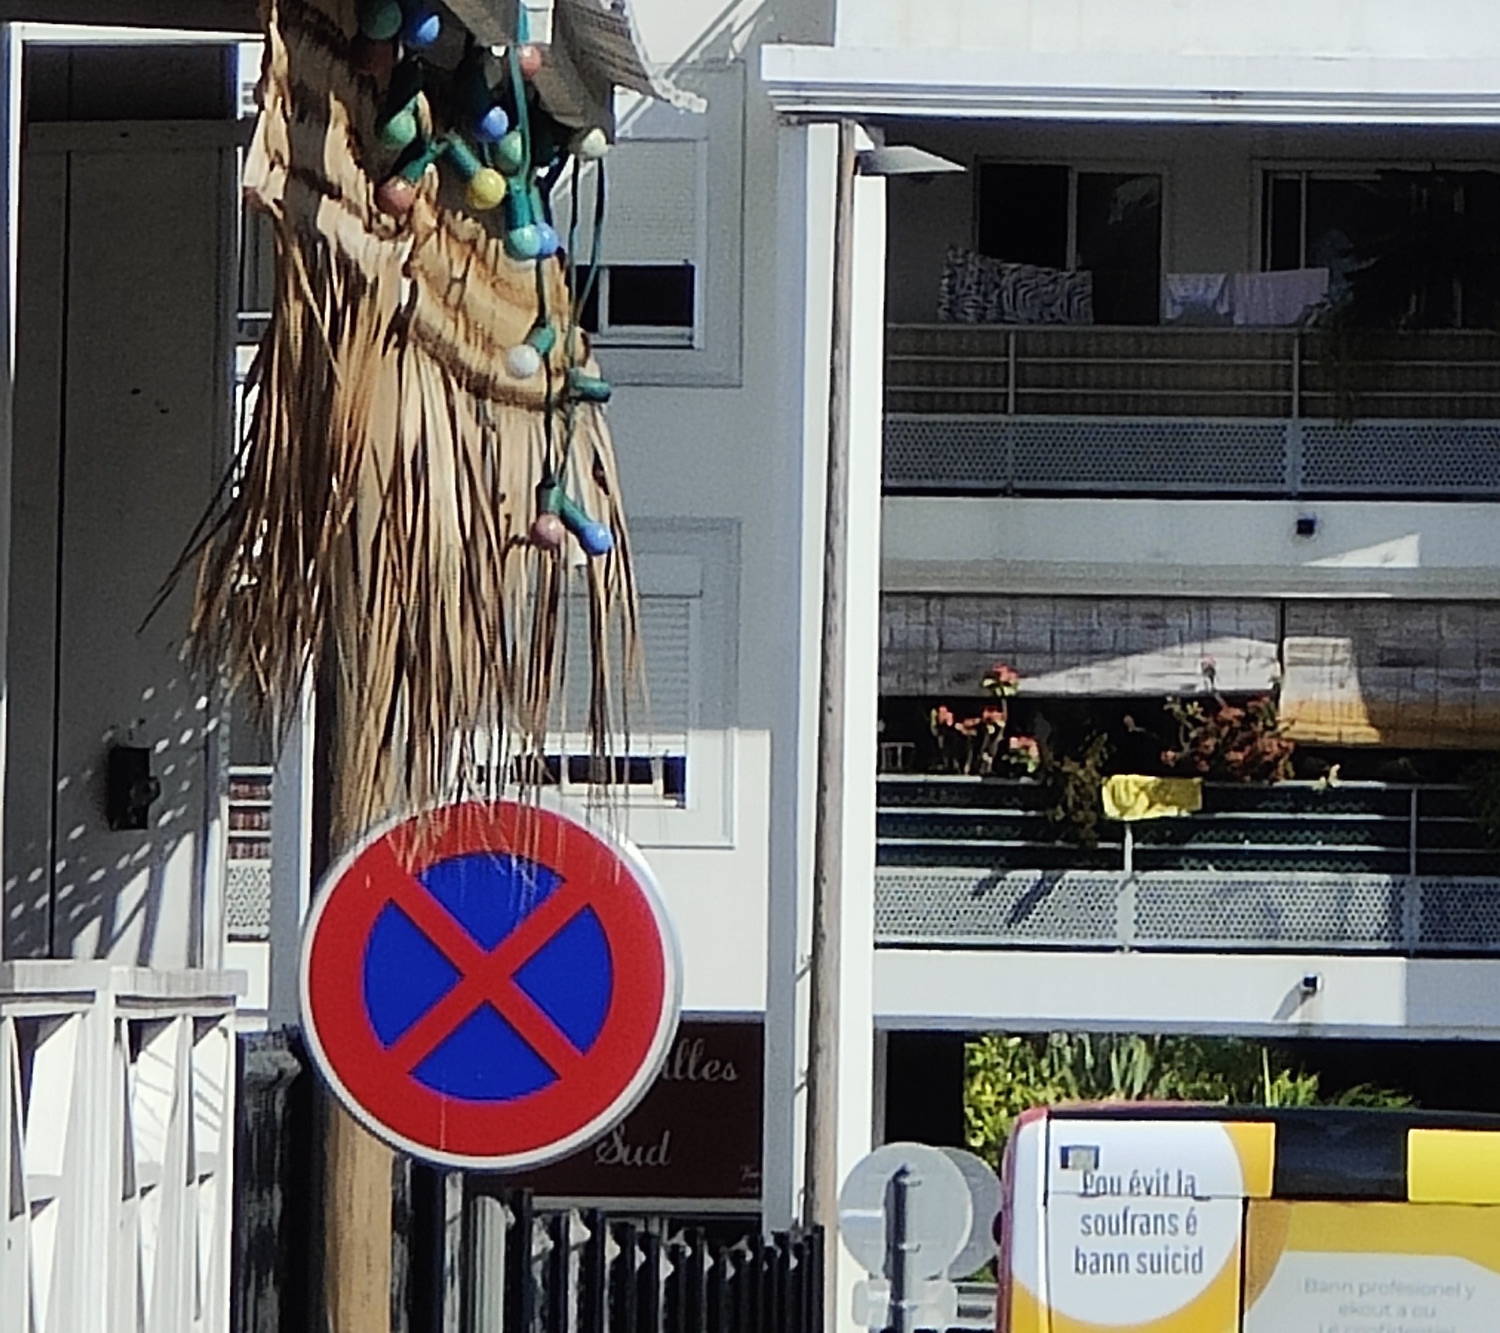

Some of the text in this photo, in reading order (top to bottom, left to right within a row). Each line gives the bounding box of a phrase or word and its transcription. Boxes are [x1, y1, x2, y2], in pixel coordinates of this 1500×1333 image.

[595, 1123, 672, 1167] Sud
[1129, 1169, 1170, 1197] évit
[1178, 1169, 1196, 1197] la
[1080, 1205, 1198, 1237] soufrans é
[1074, 1245, 1204, 1276] bann suicid
